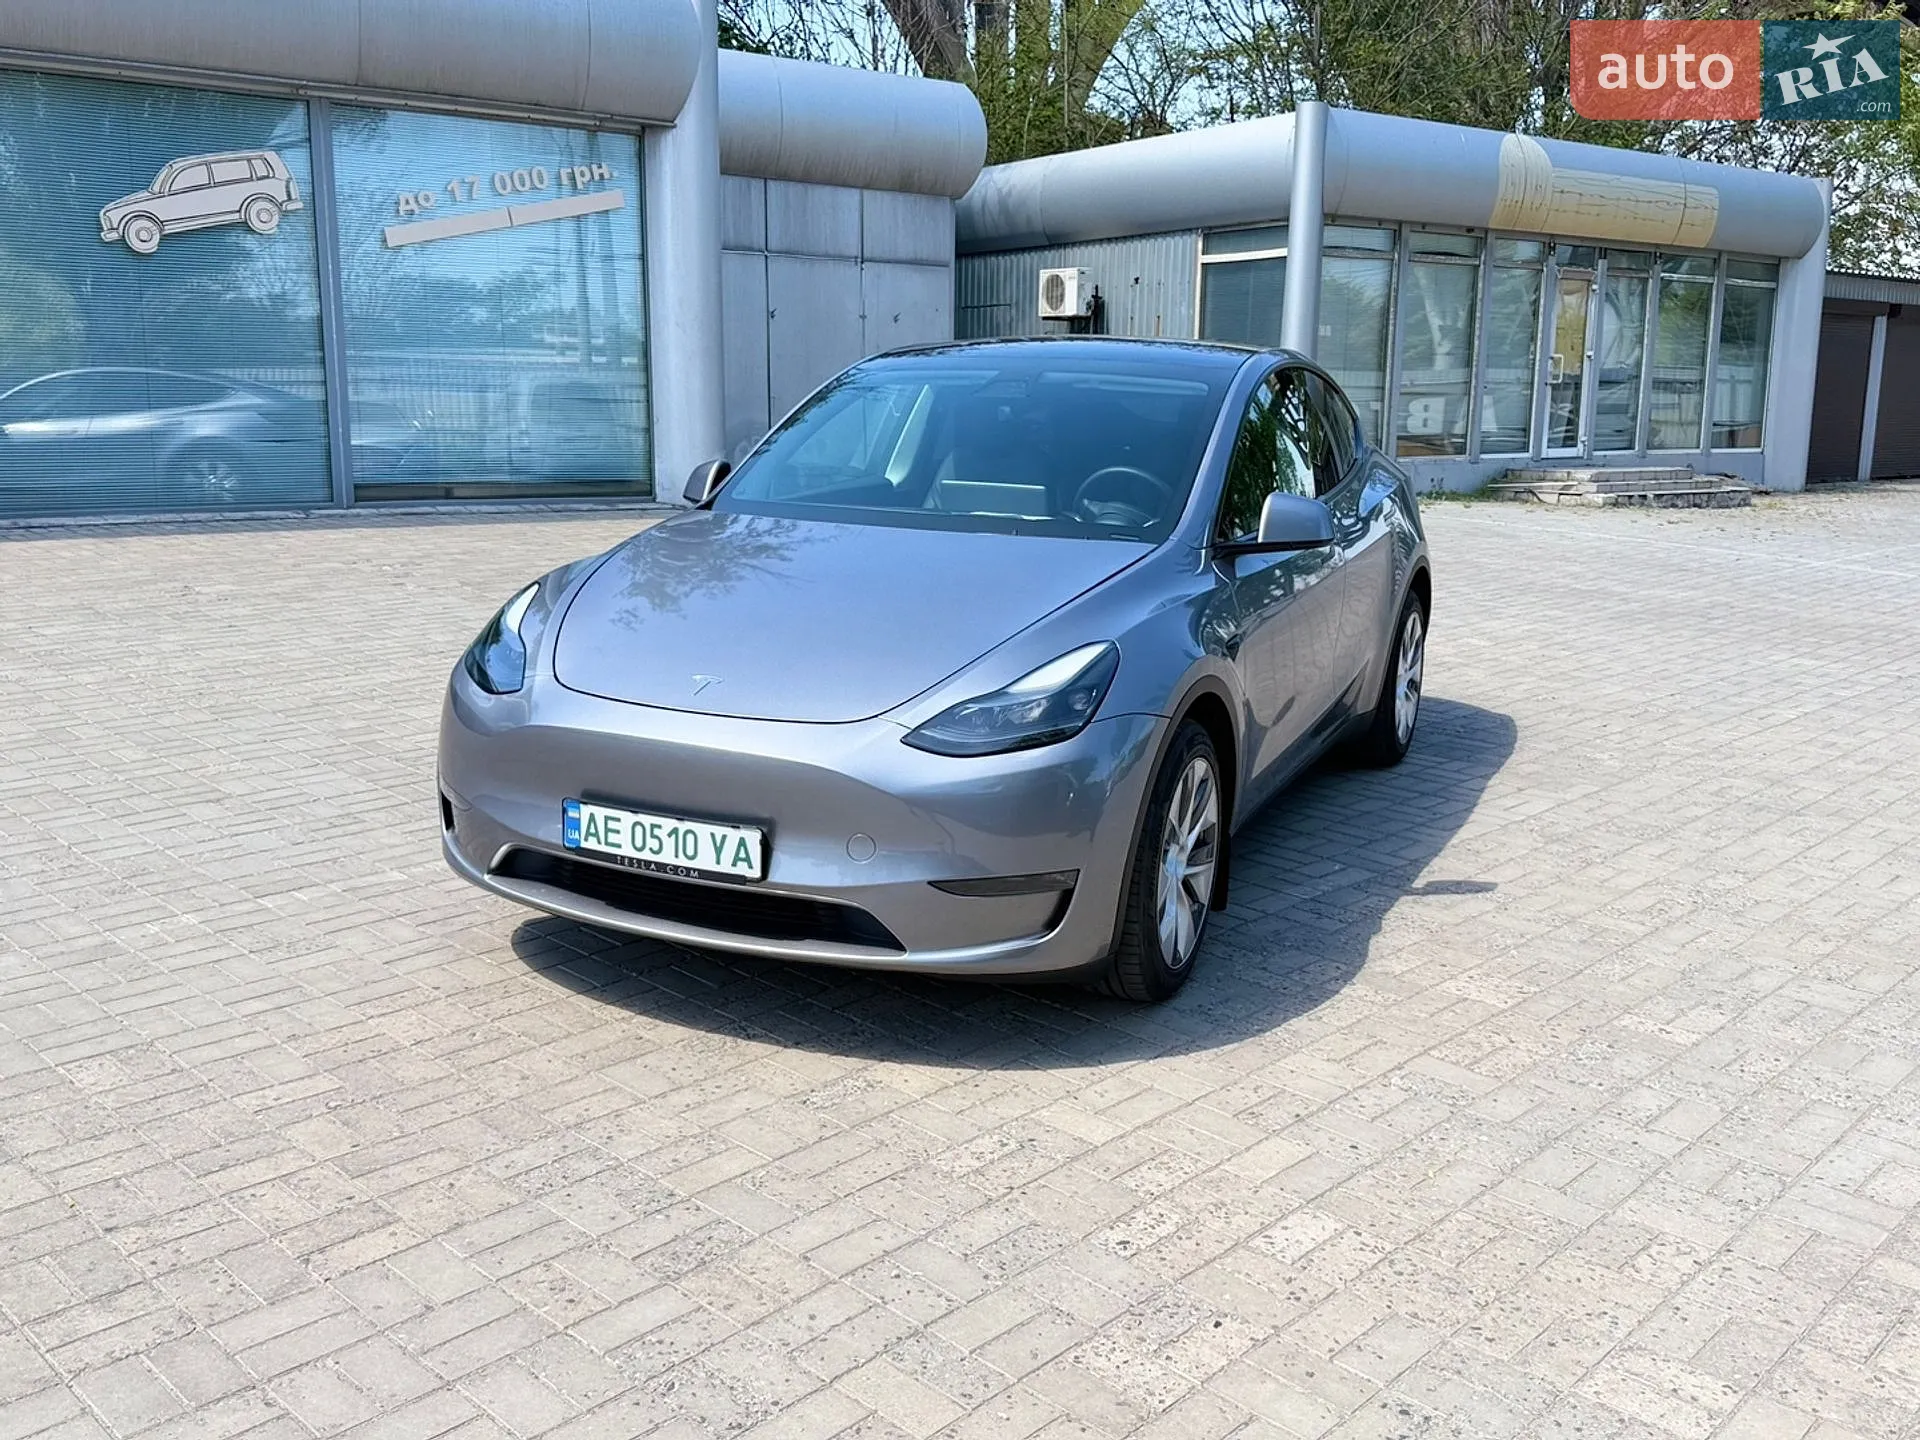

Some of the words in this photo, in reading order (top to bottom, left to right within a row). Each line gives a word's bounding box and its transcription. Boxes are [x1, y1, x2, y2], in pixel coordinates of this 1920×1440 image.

[398, 191, 437, 217] до
[447, 175, 481, 203] 17
[493, 166, 550, 196] 000
[567, 828, 580, 841] UA
[583, 812, 622, 849] AE
[631, 821, 698, 861] 0510
[710, 832, 754, 870] YA
